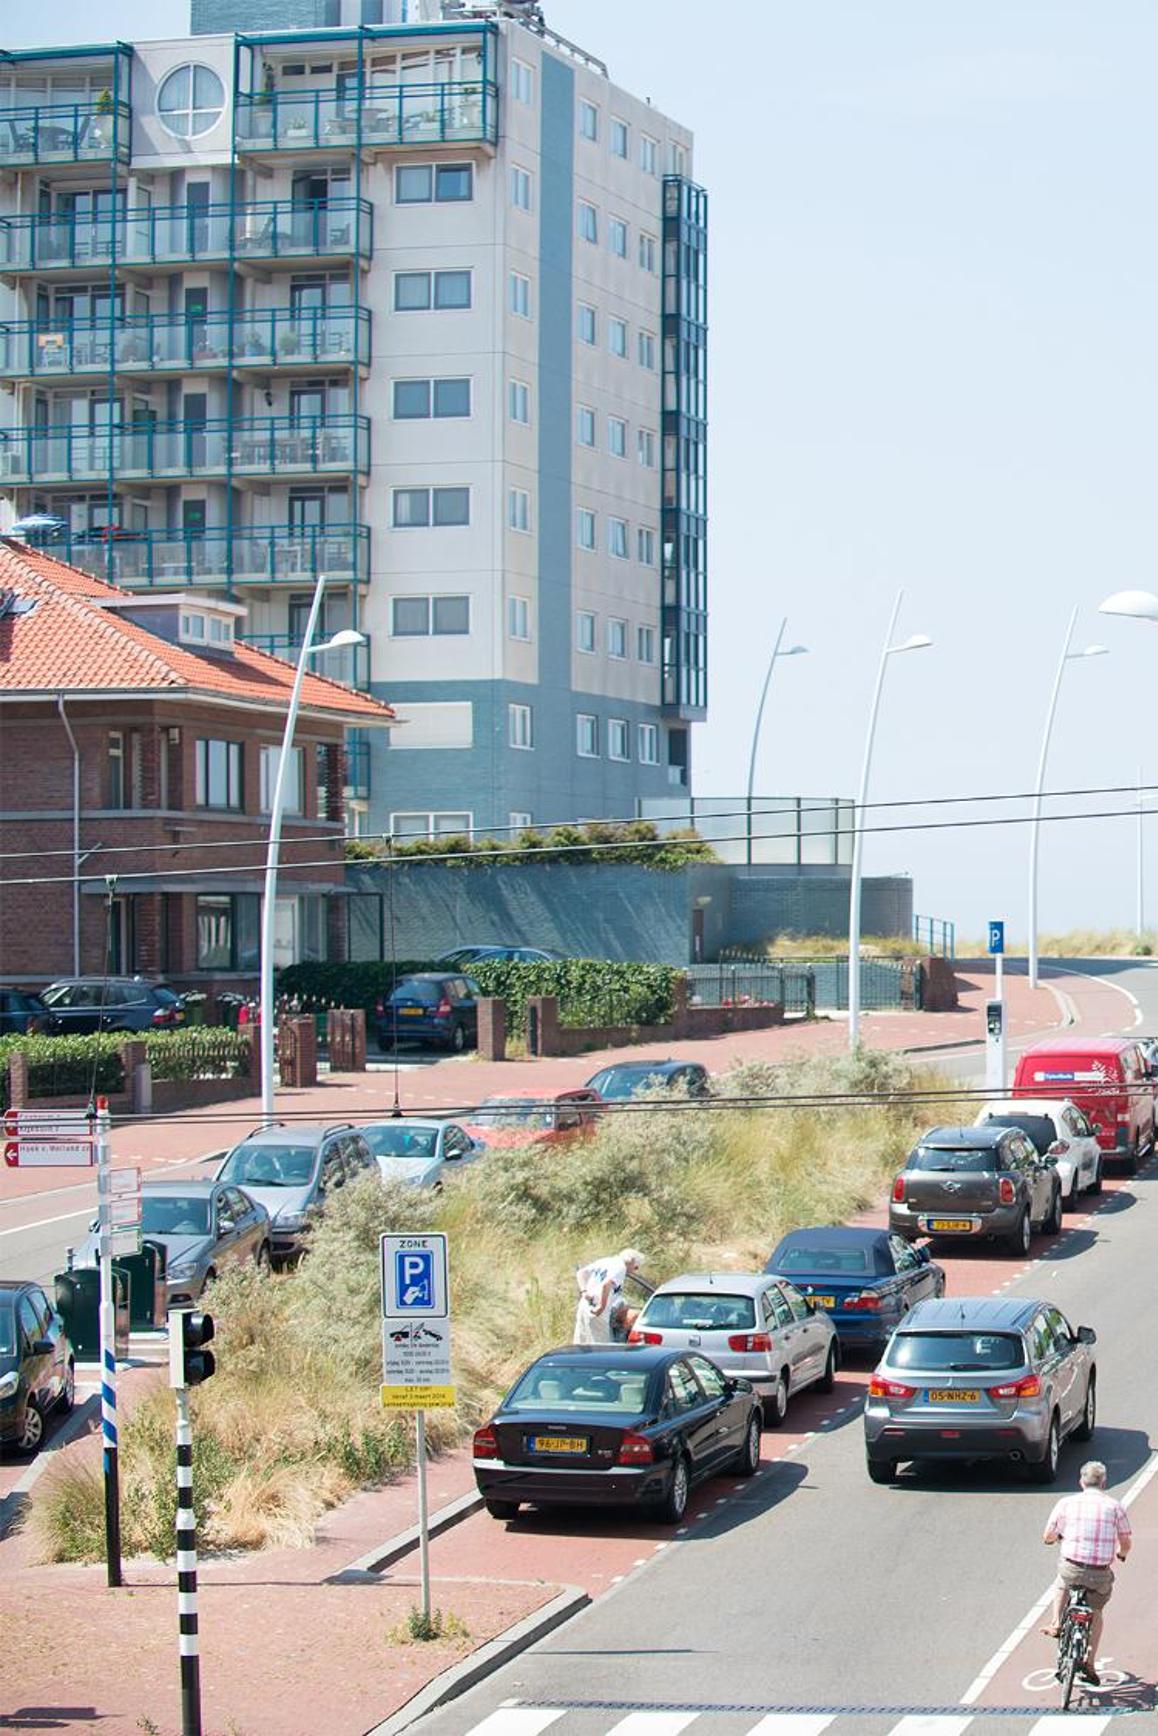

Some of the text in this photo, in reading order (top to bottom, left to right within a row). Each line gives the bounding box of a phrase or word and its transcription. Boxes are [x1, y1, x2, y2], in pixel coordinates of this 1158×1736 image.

[399, 1240, 428, 1248] ZONE
[403, 1256, 425, 1285] P
[930, 1390, 977, 1401] 05-NHZ-6
[537, 1437, 584, 1450] 96-JP-BH
